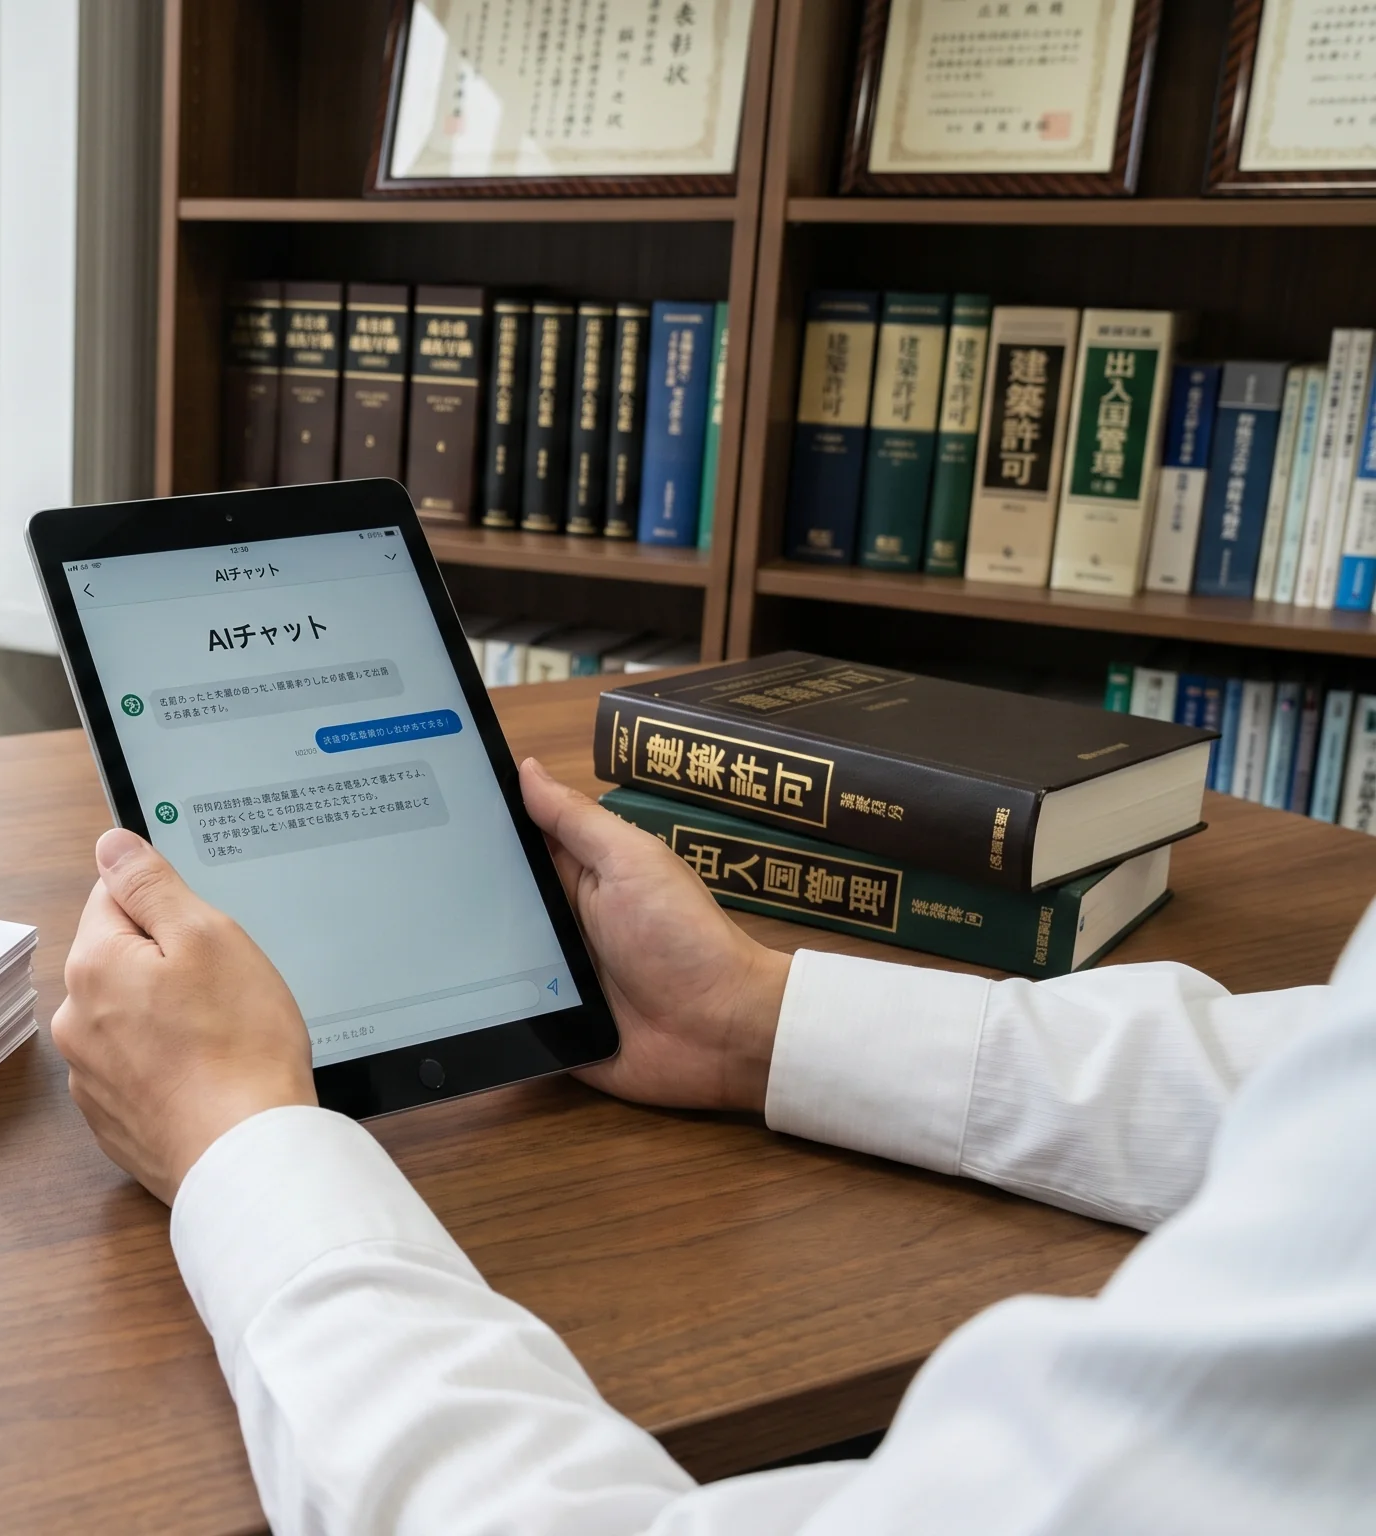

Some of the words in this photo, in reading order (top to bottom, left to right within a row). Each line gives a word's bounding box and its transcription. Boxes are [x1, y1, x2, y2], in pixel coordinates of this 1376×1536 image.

[999, 348, 1050, 486] 建築許可
[1090, 350, 1137, 479] 出入国管理
[214, 563, 280, 583] AIチャット
[208, 614, 328, 652] AIチャット
[645, 732, 814, 808] 建築許可
[683, 843, 888, 917] 出入国管理
